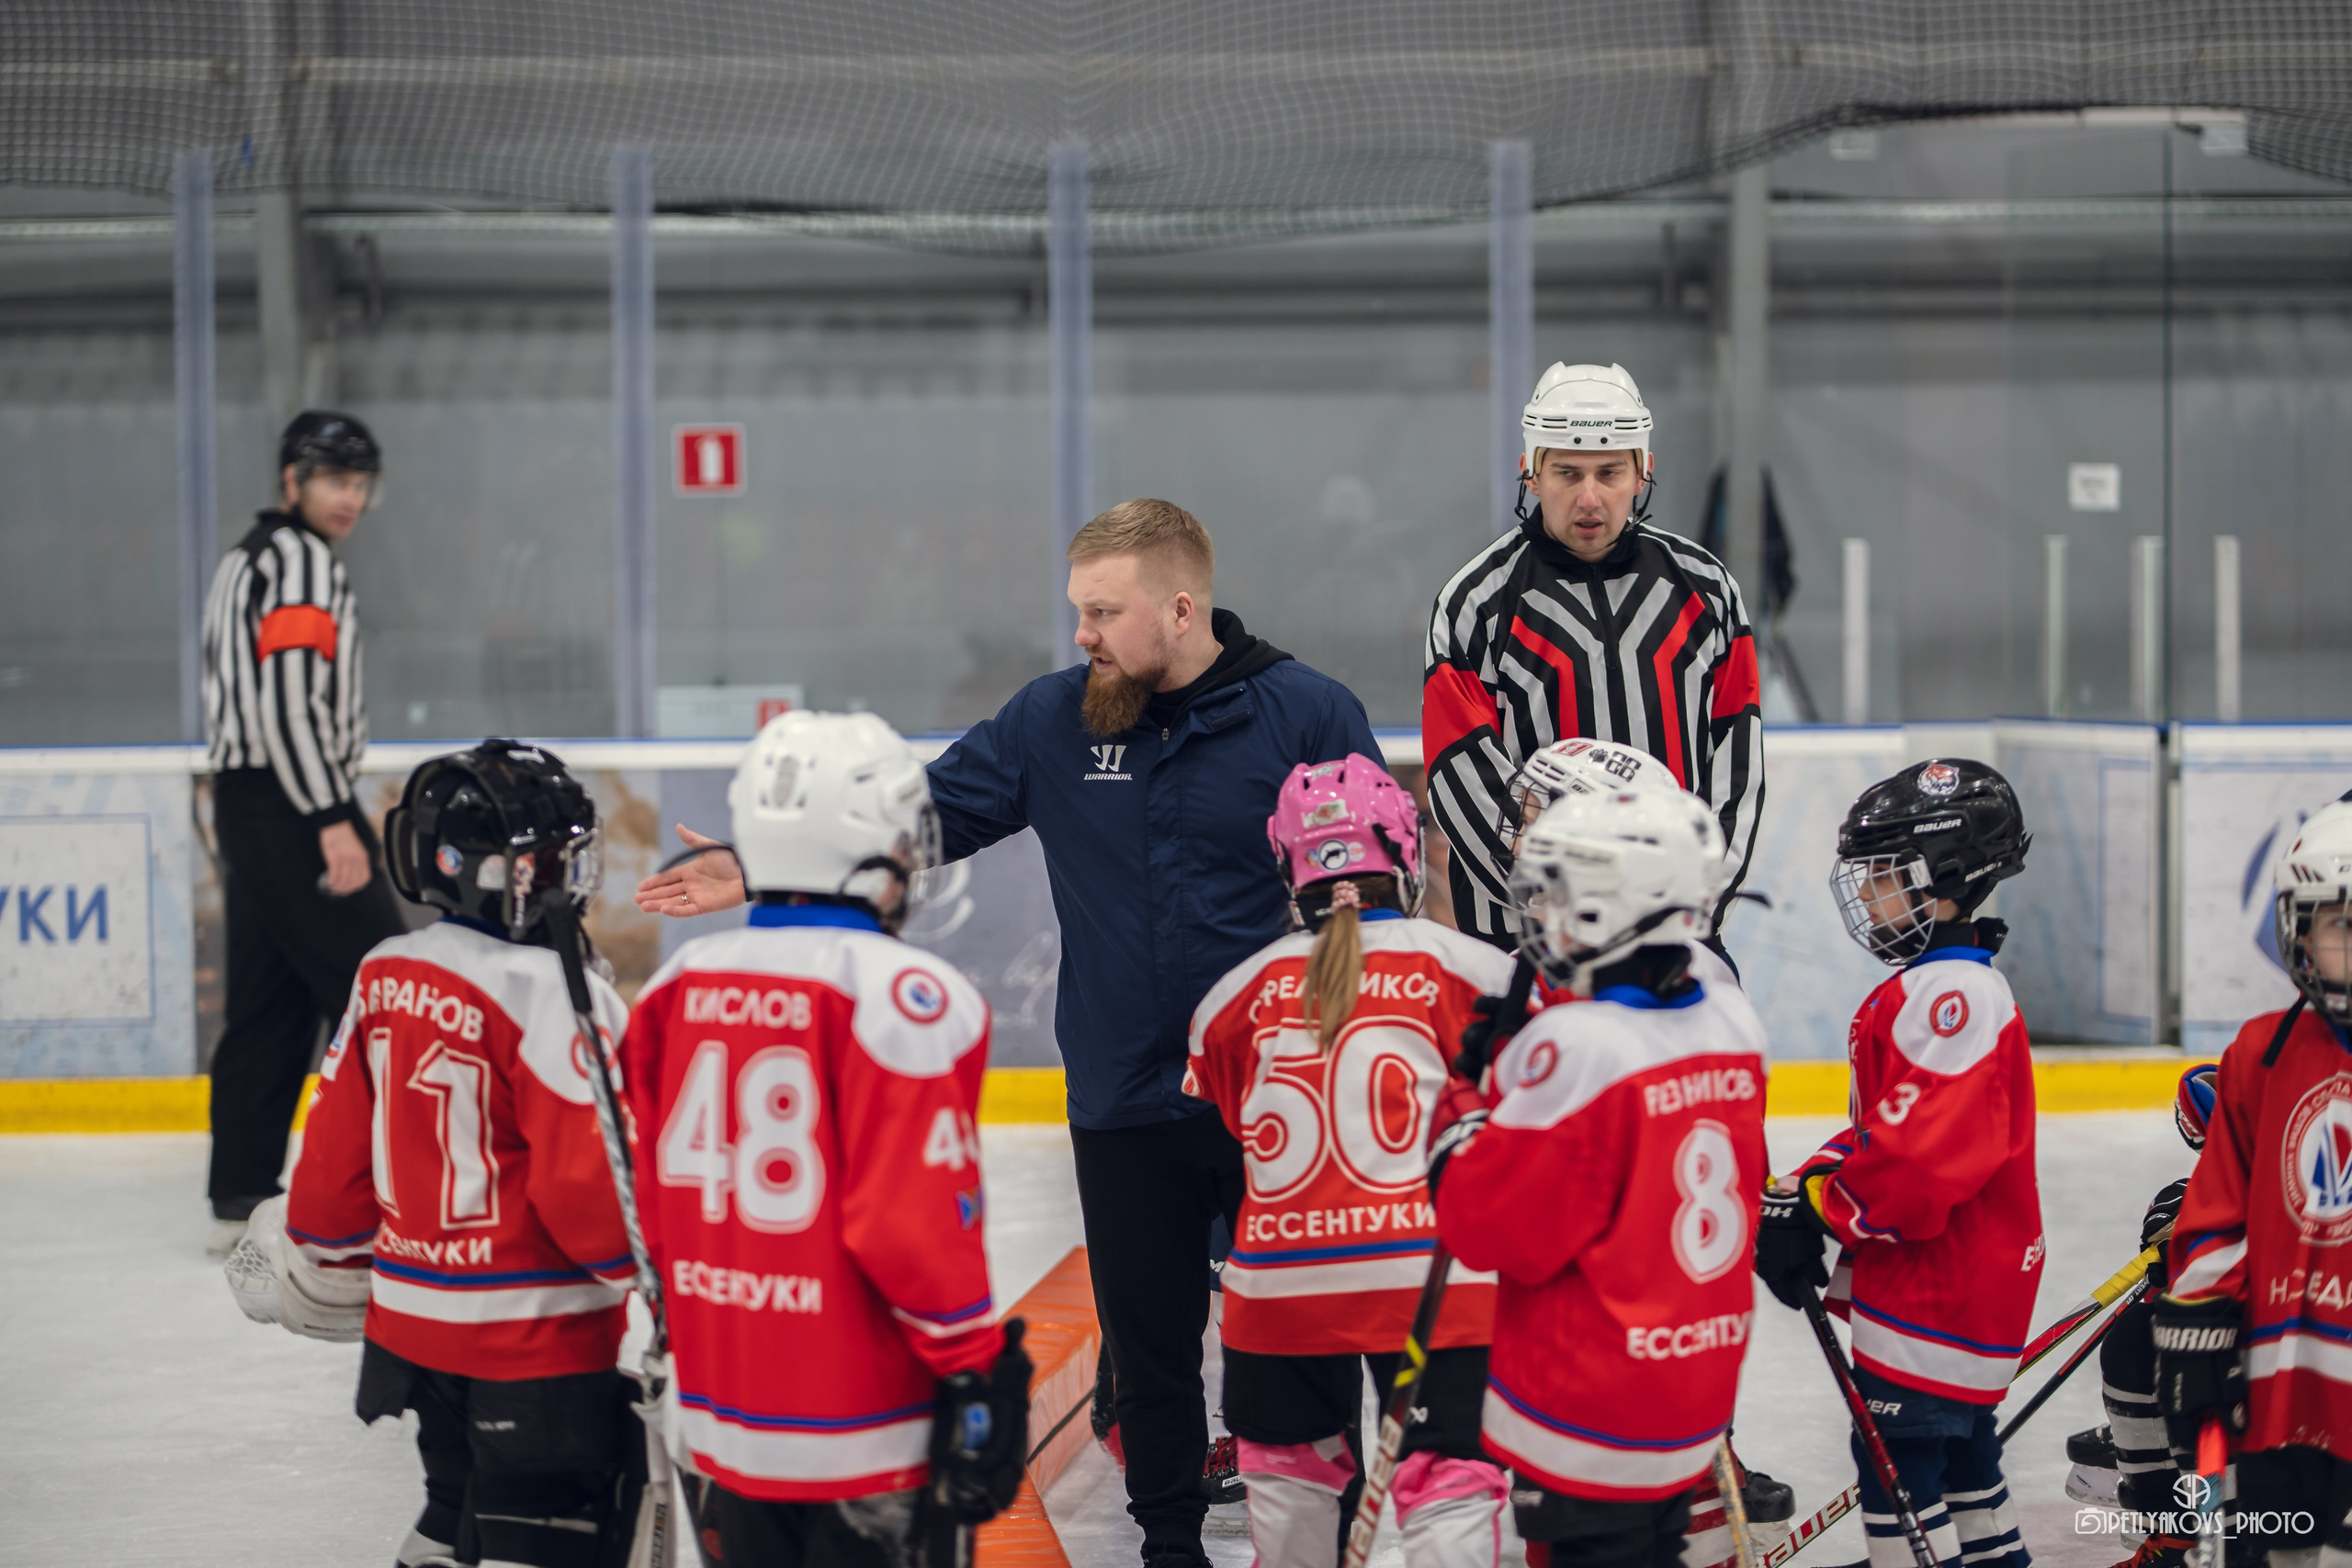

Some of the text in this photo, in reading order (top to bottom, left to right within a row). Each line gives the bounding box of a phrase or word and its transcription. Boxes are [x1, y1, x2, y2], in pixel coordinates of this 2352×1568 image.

[1569, 420, 1613, 428] BAUER
[1083, 773, 1133, 781] WARRIOR
[1913, 818, 1962, 834] BAUER
[1240, 1015, 1449, 1203] 50
[1876, 1082, 1922, 1126] 3
[367, 1026, 500, 1230] 11
[656, 1040, 827, 1234] 48
[1246, 1201, 1436, 1242] ЕССЕНТУКИ
[1671, 1117, 1747, 1283] 8
